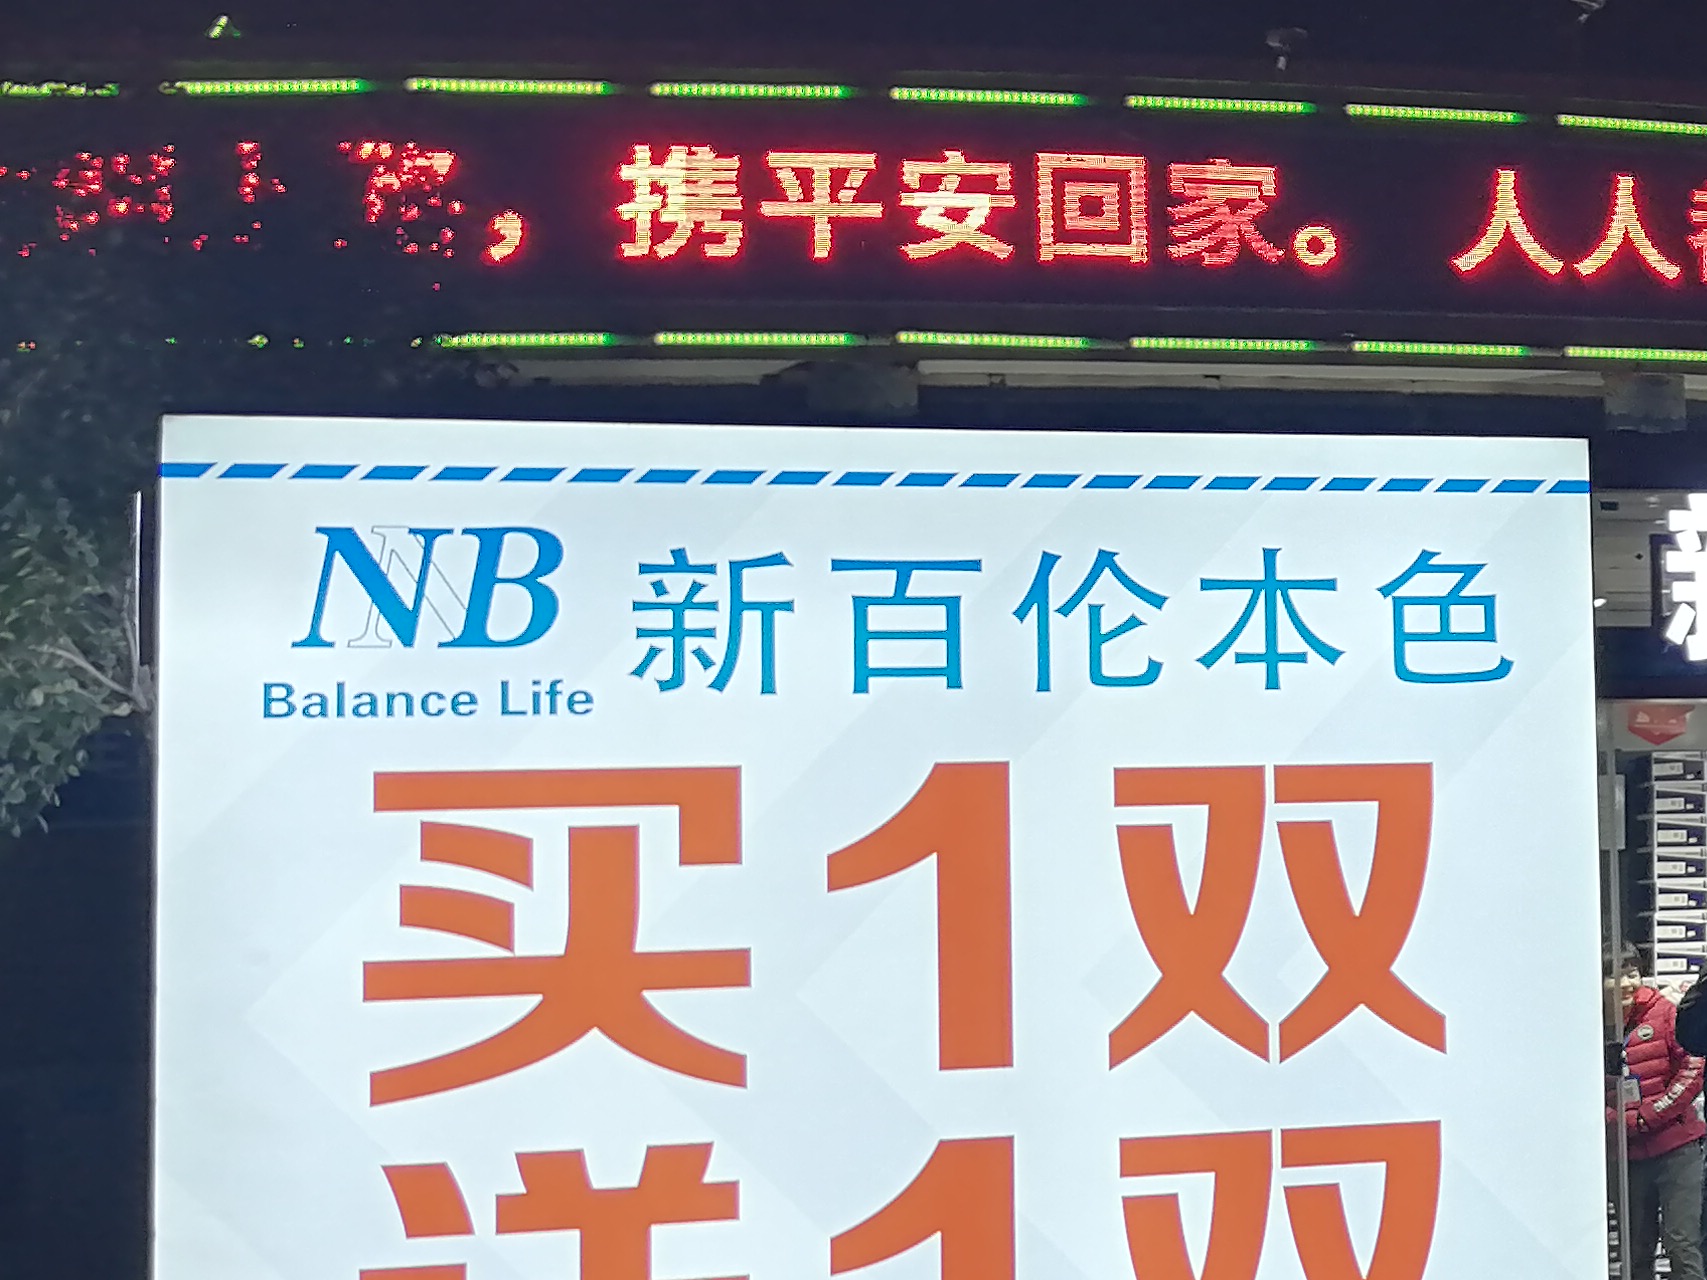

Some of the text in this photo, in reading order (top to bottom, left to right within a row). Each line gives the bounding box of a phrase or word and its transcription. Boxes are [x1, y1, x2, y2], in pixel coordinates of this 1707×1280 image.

[630, 546, 1516, 696] 新百伦本色
[262, 678, 595, 719] Balance Life
[361, 760, 1448, 1108] 买1双
